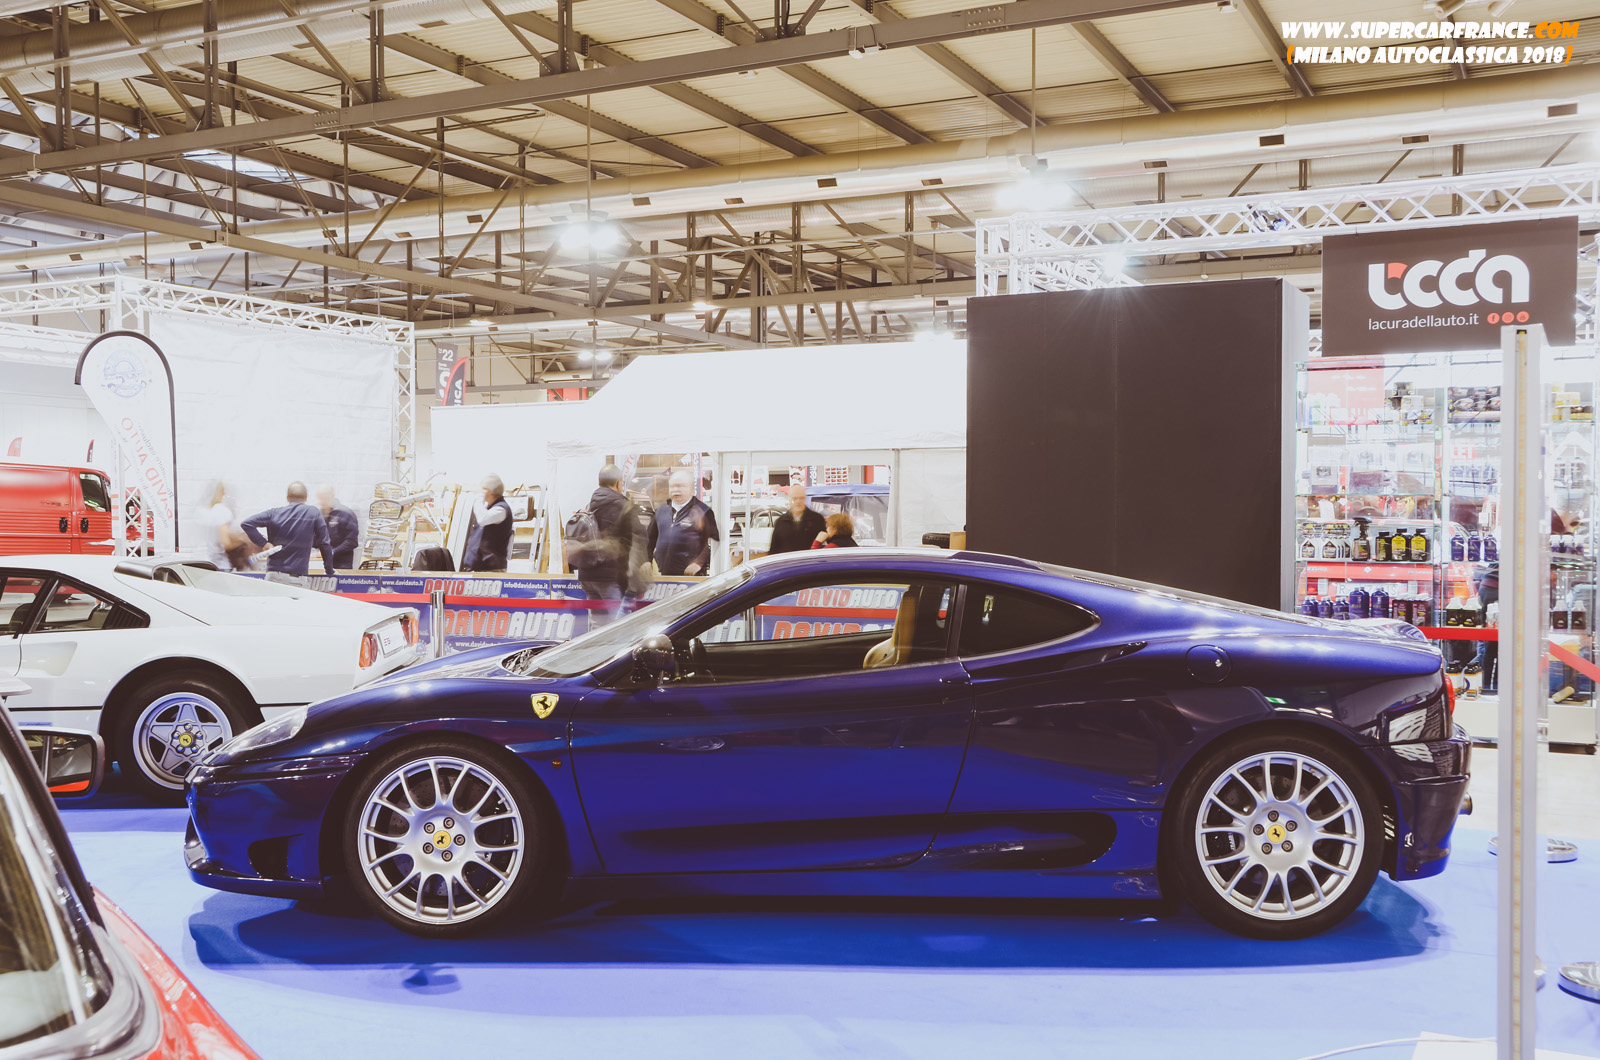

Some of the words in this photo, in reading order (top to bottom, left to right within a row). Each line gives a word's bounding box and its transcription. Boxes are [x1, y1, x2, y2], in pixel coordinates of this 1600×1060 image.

[1368, 313, 1479, 330] lacuradellauto.it
[338, 578, 379, 586] info@davidauto.it
[382, 579, 424, 587] www.davidauto.it
[503, 581, 548, 590] info@davidauto.it
